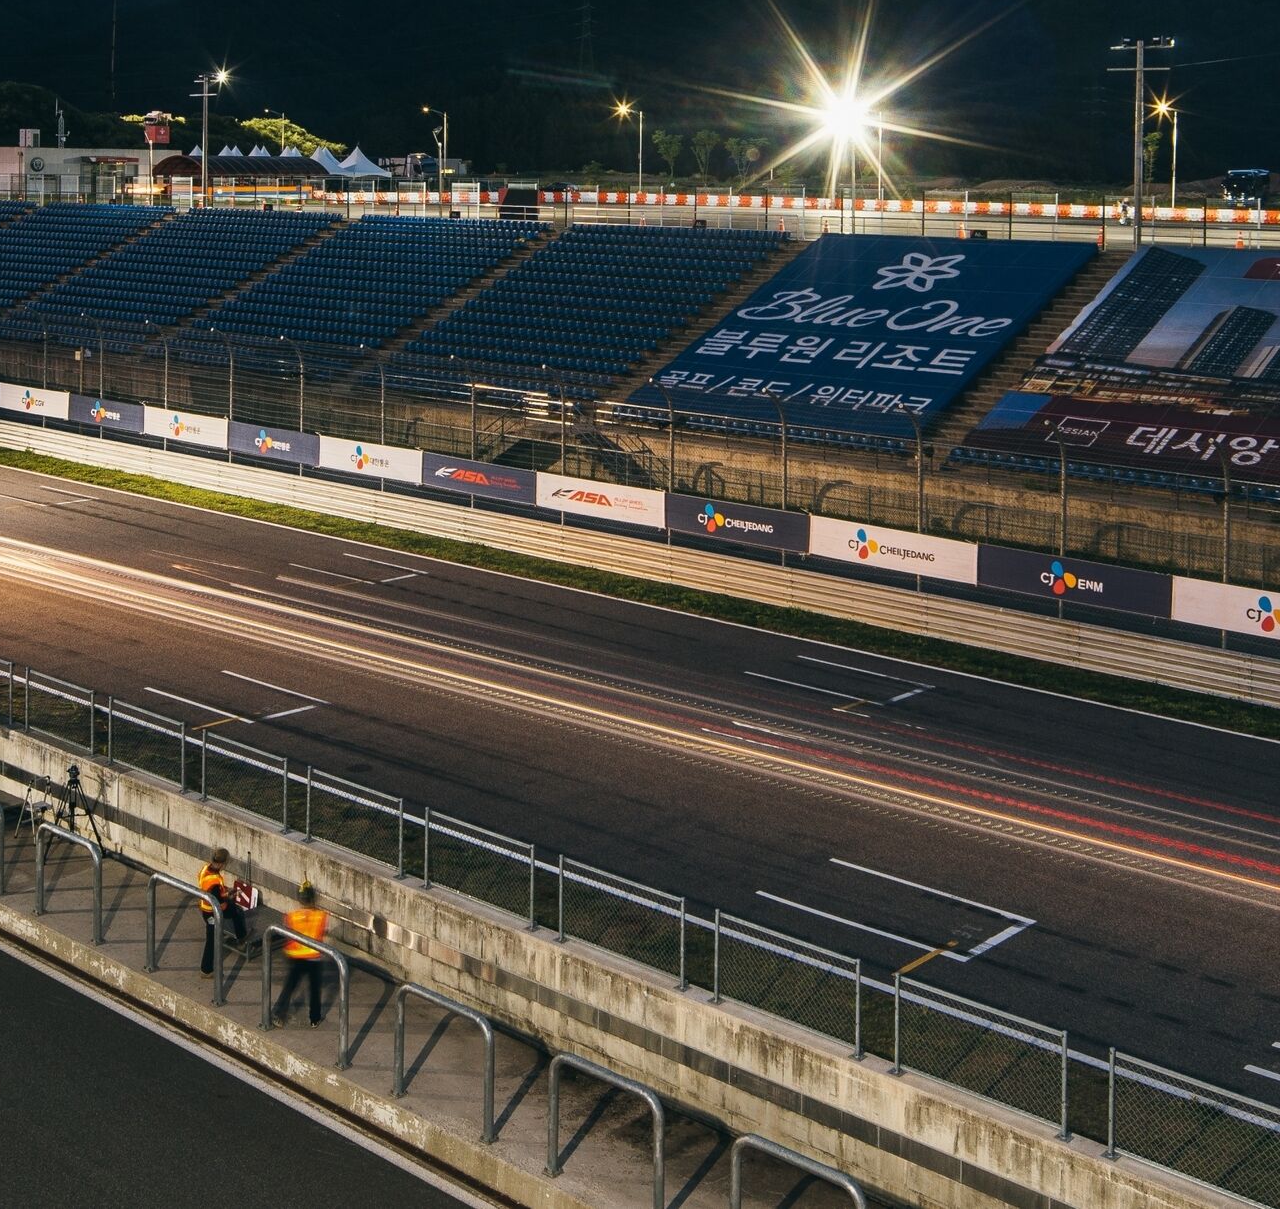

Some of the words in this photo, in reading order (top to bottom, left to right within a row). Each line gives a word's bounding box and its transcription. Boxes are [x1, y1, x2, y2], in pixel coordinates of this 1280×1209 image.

[737, 287, 888, 328] Blue
[886, 299, 1014, 338] One
[695, 327, 836, 365] 블루원
[833, 340, 979, 376] 리조트
[35, 399, 45, 407] CGV
[659, 369, 716, 393] 골프
[809, 383, 934, 415] 워터파크
[1126, 426, 1280, 466] 데시앙
[450, 469, 491, 486] ASA
[568, 491, 612, 507] ASA
[698, 514, 708, 526] CJ
[725, 518, 774, 534] CHEILJEDANG
[848, 539, 859, 552] CJ
[879, 545, 935, 562] CHEILJEDANG
[1040, 572, 1055, 587] CJ
[1077, 578, 1104, 594] ENM
[1246, 608, 1263, 624] CJ
